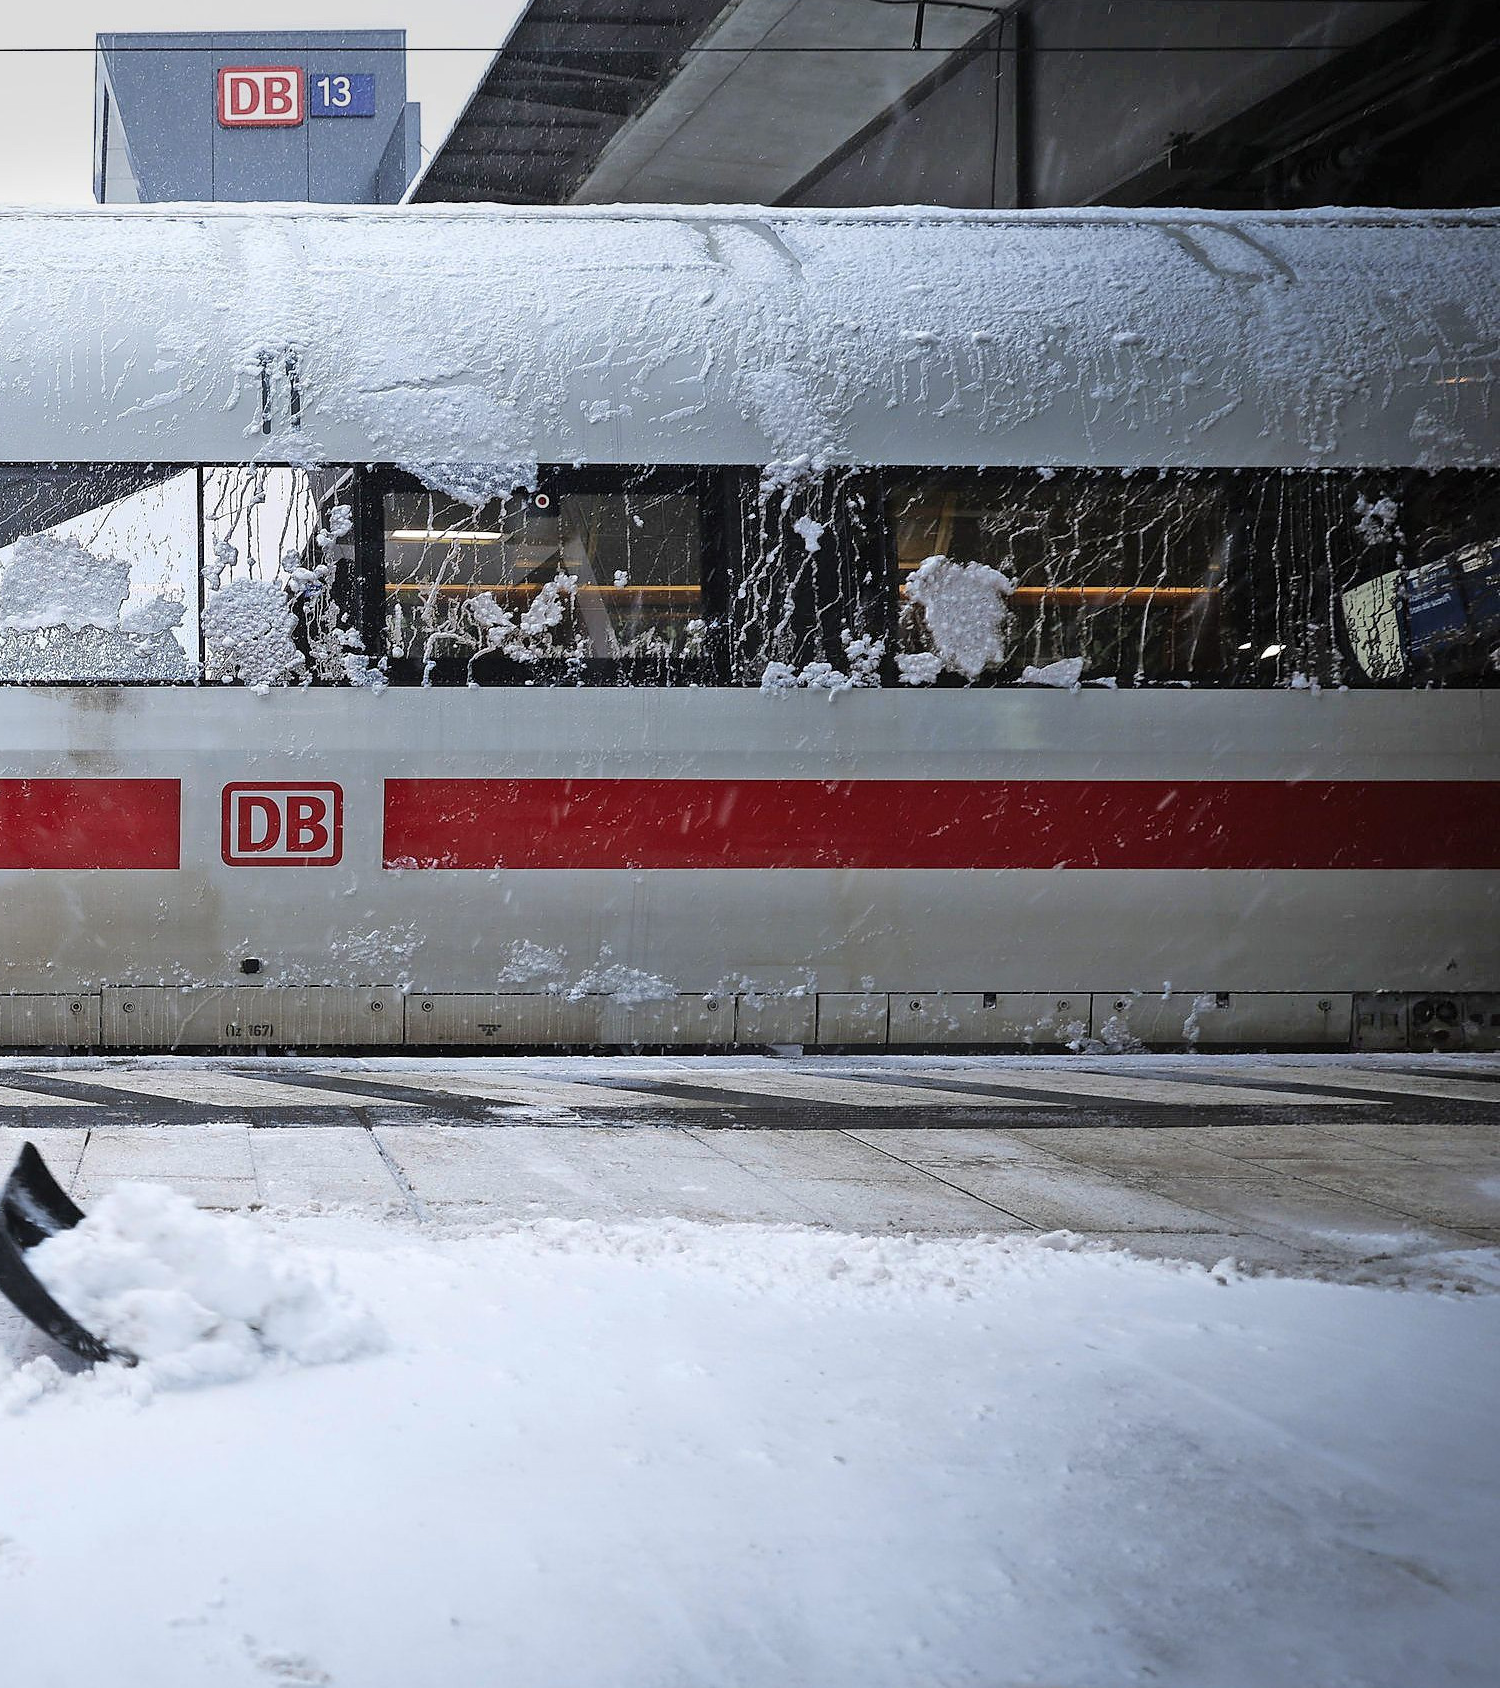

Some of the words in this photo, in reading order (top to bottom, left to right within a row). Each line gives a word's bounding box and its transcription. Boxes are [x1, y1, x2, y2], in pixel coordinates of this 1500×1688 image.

[228, 75, 295, 118] DB
[317, 76, 352, 108] 13
[235, 793, 331, 855] DB
